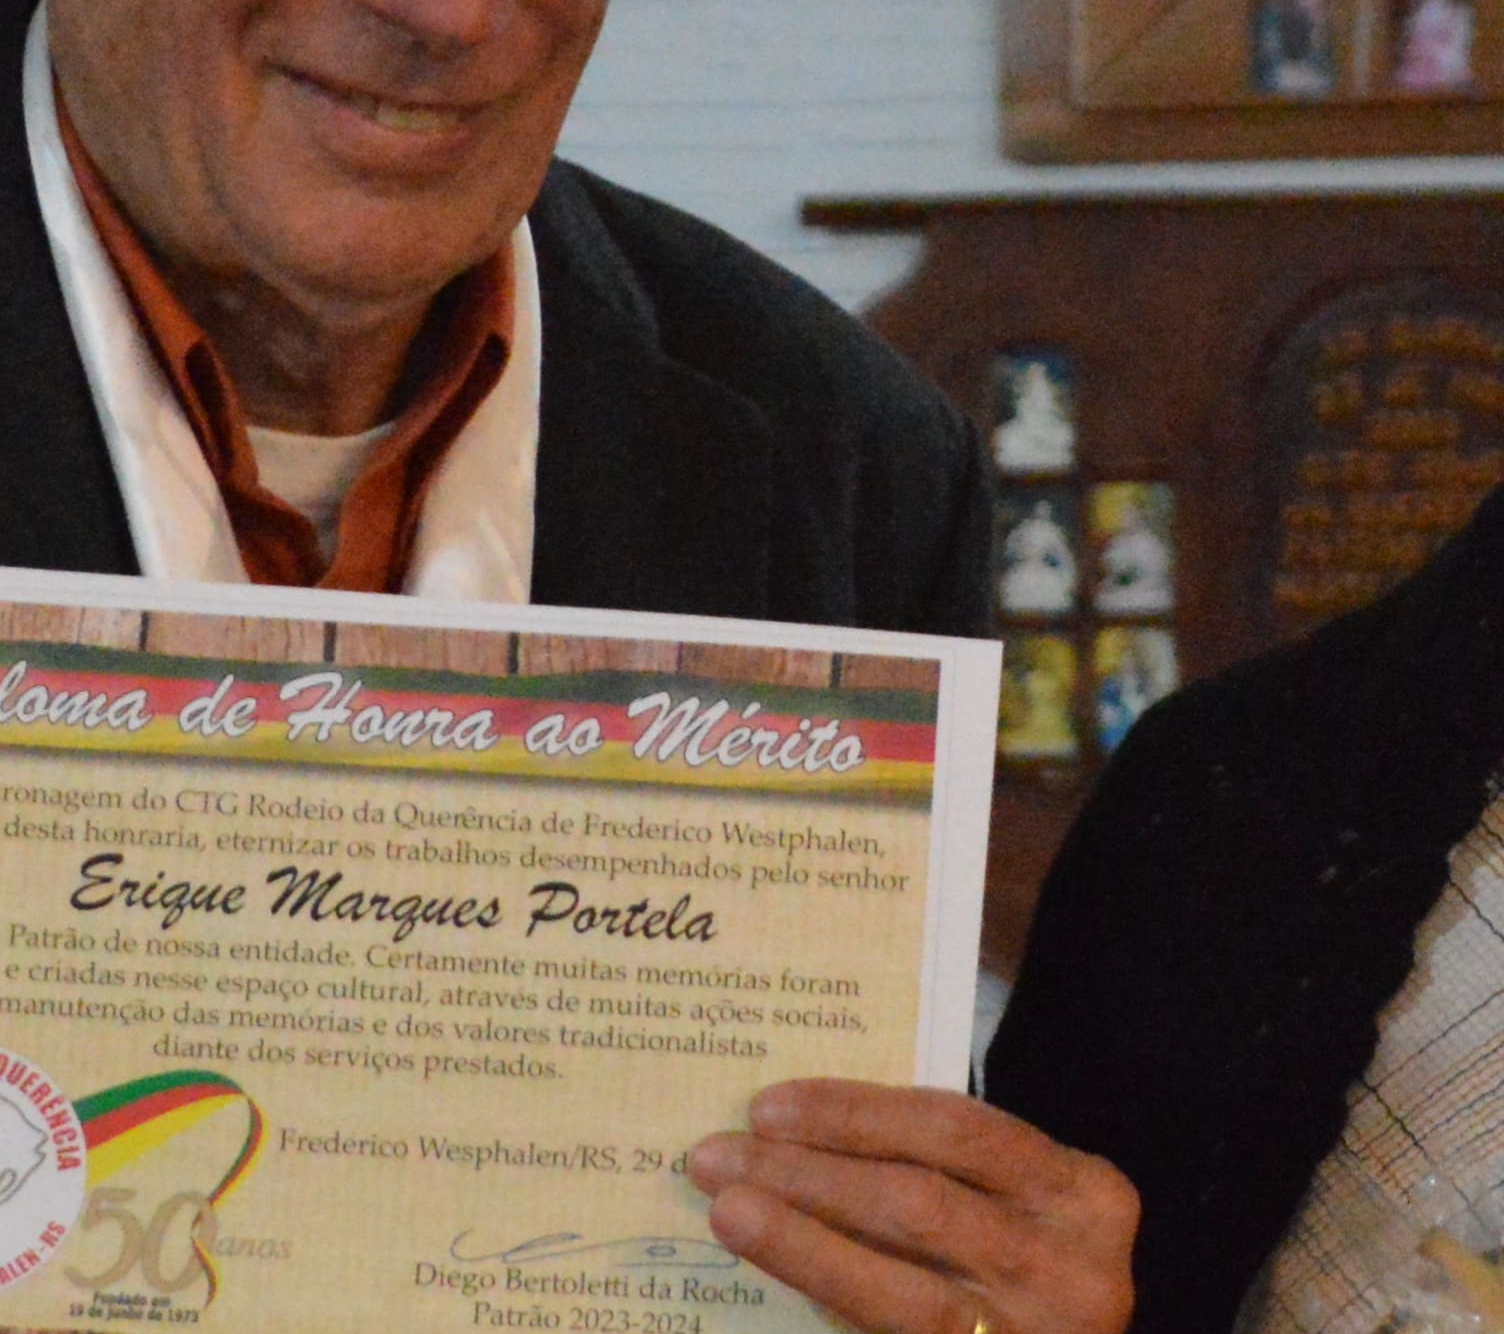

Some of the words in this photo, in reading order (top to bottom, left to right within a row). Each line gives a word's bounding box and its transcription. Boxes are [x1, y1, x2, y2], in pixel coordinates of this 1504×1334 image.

[179, 673, 256, 737] de
[280, 671, 498, 751] Honra
[524, 711, 603, 756] ao
[627, 690, 866, 772] Mérito
[4, 816, 74, 842] desta
[83, 820, 207, 853] honraria,
[216, 830, 337, 860] eternizar
[347, 841, 376, 860] os
[386, 839, 511, 869] trabalhos
[519, 845, 742, 881] desempenhados
[751, 861, 809, 890] pelo
[817, 865, 909, 893] senhor
[133, 788, 167, 813] do
[175, 789, 239, 816] CTG
[249, 794, 344, 823] Rodeio
[352, 800, 385, 825] da
[394, 801, 532, 834] Querência
[541, 810, 574, 836] de
[584, 813, 712, 844] Frederico
[722, 820, 888, 859] Westphalen,
[70, 853, 247, 930] Erique
[266, 865, 503, 942] Marques
[526, 880, 718, 943] Portela
[9, 923, 95, 951] Patrão
[104, 927, 137, 953] de
[146, 936, 221, 959] nossa
[229, 937, 356, 967] entidade.
[366, 948, 526, 977] Certamente
[534, 956, 628, 983] muitas
[636, 962, 772, 992] memórias
[780, 967, 861, 998] foram
[5, 964, 20, 980] e
[28, 960, 126, 988] criadas
[134, 971, 208, 992] nesse
[215, 975, 305, 1002] espaço
[316, 977, 431, 1008] cultural,
[440, 985, 538, 1012] através
[546, 988, 581, 1014] de
[589, 992, 682, 1019] muitas
[690, 998, 764, 1028] ações
[771, 1003, 869, 1035] sociais,
[153, 1033, 239, 1062] diante
[247, 1038, 297, 1064] dos
[304, 1044, 415, 1075] serviços
[423, 1051, 563, 1082] prestados.
[173, 1002, 221, 1027] das
[228, 1005, 365, 1035] memórias
[372, 1019, 387, 1035] e
[395, 1014, 444, 1041] dos
[453, 1018, 551, 1046] valores
[559, 1026, 768, 1058] tradicionalistas
[280, 1128, 409, 1159] Frederico
[419, 1135, 623, 1174] Wesphalen/RS,
[634, 1149, 663, 1173] 29
[671, 1151, 690, 1175] d
[39, 1220, 67, 1248] RS
[64, 1186, 219, 1294] 50
[215, 1236, 294, 1259] anos
[88, 1303, 103, 1317] de
[147, 1308, 163, 1321] de
[414, 1261, 496, 1294] Diego
[504, 1266, 630, 1298] Bertoletti
[638, 1274, 673, 1299] da
[683, 1278, 765, 1306] Rocha
[473, 1301, 560, 1330] Patrão
